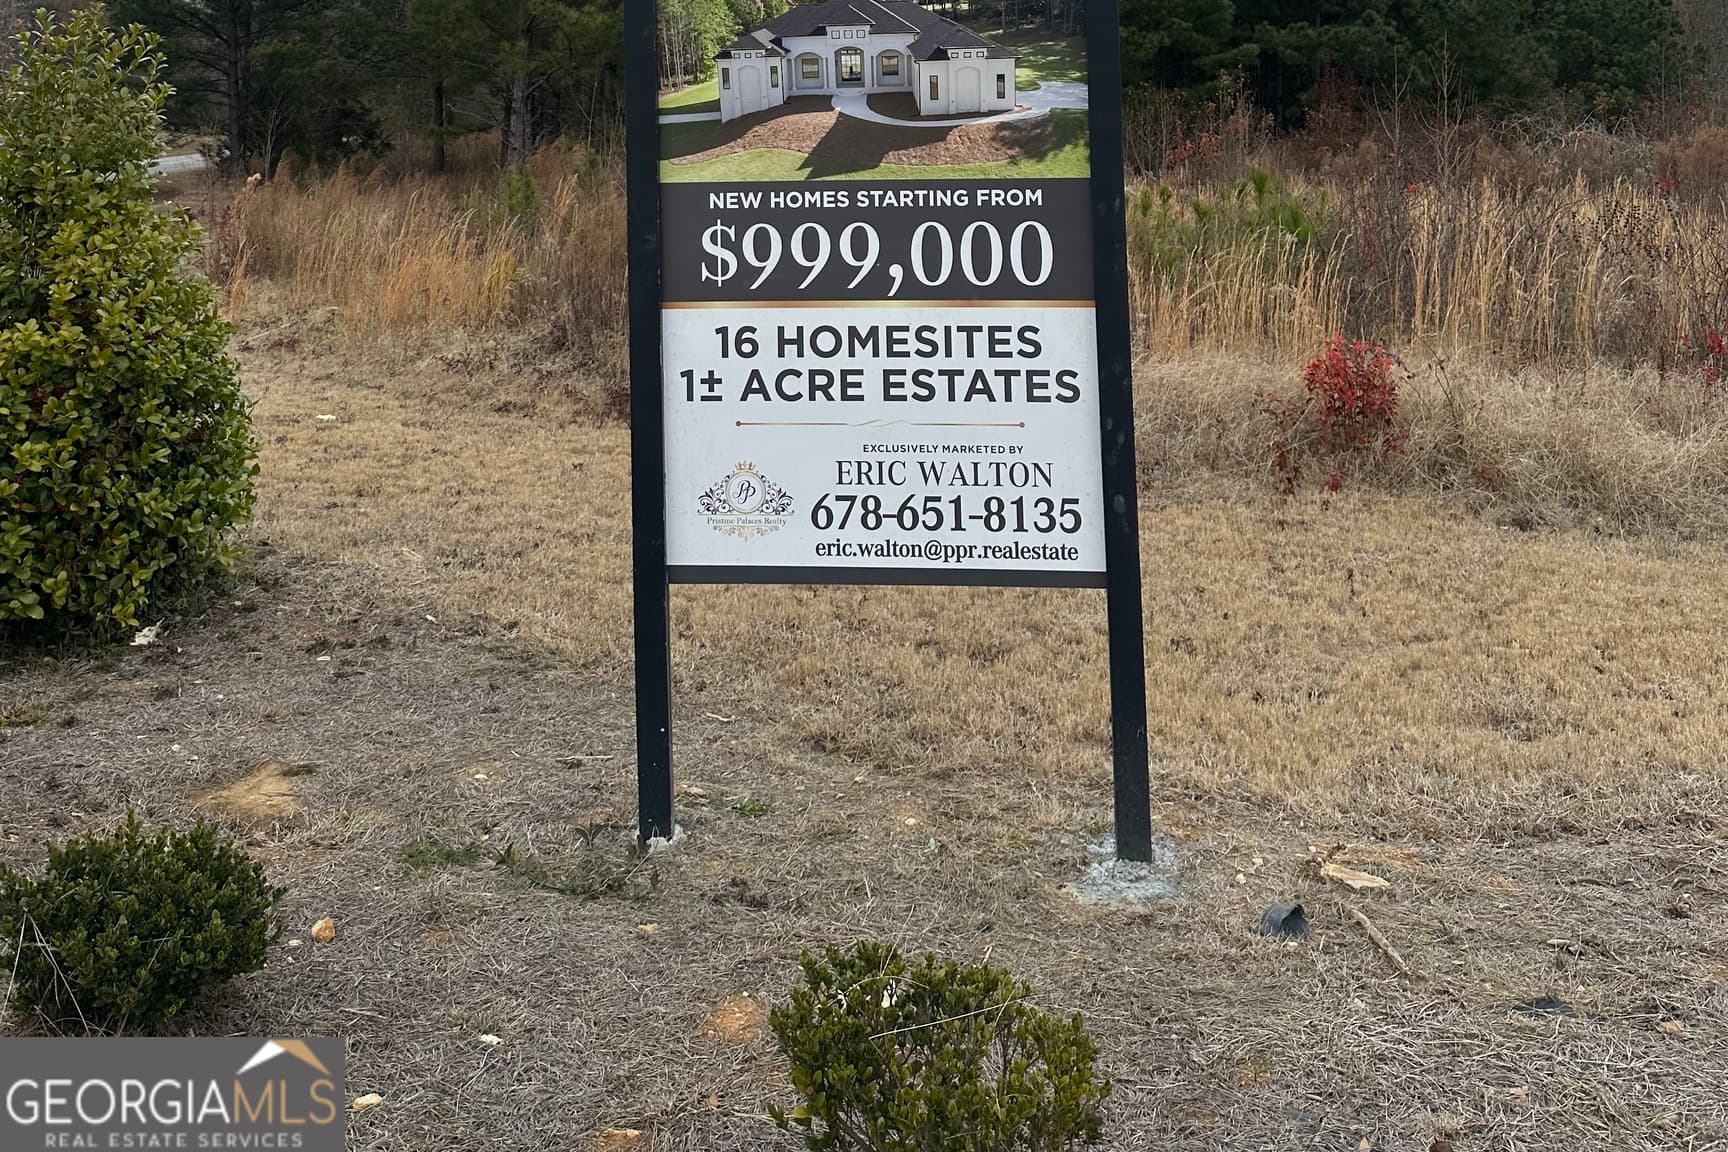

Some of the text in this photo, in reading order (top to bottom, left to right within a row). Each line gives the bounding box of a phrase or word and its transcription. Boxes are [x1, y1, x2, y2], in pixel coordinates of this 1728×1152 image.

[709, 189, 1043, 209] NEW HOMES STARTING FROM
[701, 219, 1054, 297] $999,000
[715, 325, 1042, 358] 16 HOMESITES
[680, 369, 1081, 403] 1± ACRE ESTATES
[863, 444, 1024, 455] EXCLUSIVELY MARKETED BY
[835, 460, 1053, 488] ERIC WALTON
[707, 517, 787, 527] Pristine Palaces Realty
[810, 493, 1082, 534] 678-651-8135
[815, 539, 1079, 563] eric.walton@ppr.realestate
